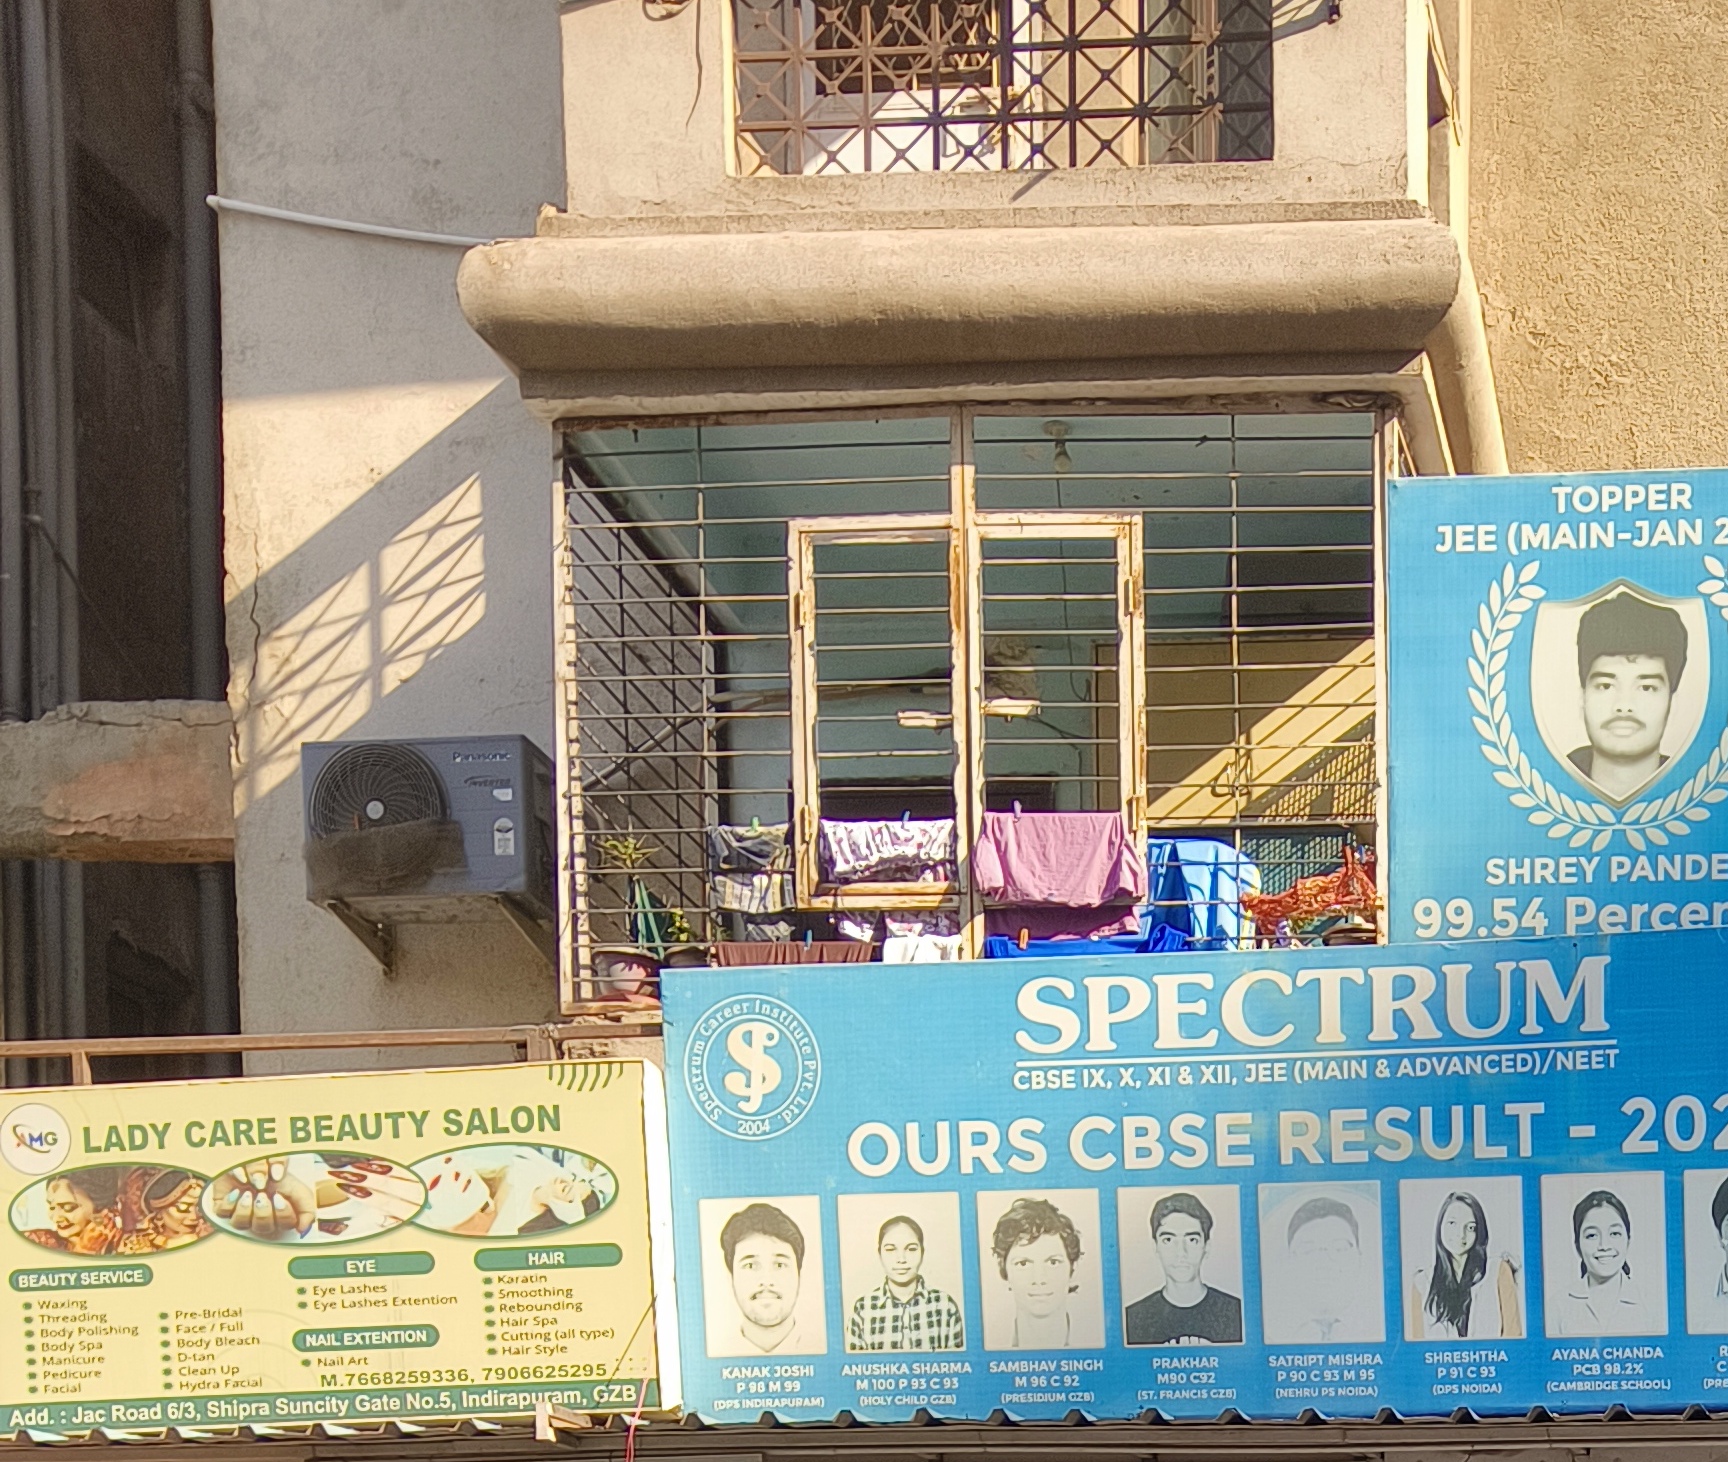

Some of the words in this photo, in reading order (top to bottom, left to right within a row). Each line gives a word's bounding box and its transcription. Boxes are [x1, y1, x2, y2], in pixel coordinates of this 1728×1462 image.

[1552, 482, 1692, 513] TOPPER
[1435, 525, 1498, 553] JEE
[1507, 519, 1702, 554] (MAIN-JAN
[1485, 856, 1601, 885] SHREY
[1413, 896, 1549, 938] 99.54
[1015, 955, 1611, 1054] SPECTRUM
[1013, 1070, 1076, 1091] CBSE
[1082, 1069, 1113, 1091] IX,
[1119, 1069, 1142, 1090] X,
[1148, 1068, 1171, 1086] XI
[1177, 1066, 1194, 1085] &
[1200, 1065, 1236, 1087] XII,
[1245, 1063, 1288, 1083] JEE
[1293, 1059, 1369, 1085] (MAIN
[1375, 1058, 1391, 1078] &
[1396, 1049, 1620, 1079] ADVANCED)/NEET
[83, 1122, 172, 1154] LADY
[184, 1117, 278, 1149] CARE
[289, 1111, 430, 1143] BEAUTY
[443, 1105, 561, 1136] SALON
[847, 1117, 1047, 1177] OURS
[1069, 1112, 1255, 1171] CBSE
[1280, 1102, 1545, 1167] RESULT
[528, 1252, 565, 1265] HAIR
[346, 1260, 376, 1273] EYE
[19, 1273, 78, 1288] BEAUTY
[80, 1270, 144, 1285] SERVICE
[313, 1285, 336, 1296] Eye
[341, 1284, 387, 1294] Lashes
[498, 1286, 573, 1299] Smoothing
[499, 1301, 583, 1313] Rebounding
[306, 1333, 341, 1346] NAIL
[344, 1330, 427, 1346] EXTENTION
[1269, 1354, 1325, 1366] SATRIPT
[1329, 1353, 1383, 1365] MISHRA
[1425, 1350, 1508, 1364] SHRESHTHA
[1552, 1348, 1599, 1361] AYANA
[1603, 1346, 1664, 1359] CHANDA
[842, 1364, 908, 1376] ANUSHKA
[912, 1362, 971, 1375] SHARMA
[989, 1360, 1056, 1373] SAMBHAV
[1060, 1360, 1103, 1372] SINGH
[1153, 1357, 1219, 1369] PRAKHAR
[482, 1364, 607, 1381] 7906625295
[722, 1367, 770, 1380] KANAK
[775, 1365, 814, 1377] JOSHI
[10, 1409, 55, 1427] Add.
[72, 1407, 106, 1424] Jac
[111, 1403, 162, 1420] Road
[167, 1403, 201, 1421] 6/3,
[207, 1399, 270, 1421] Shipra
[276, 1393, 349, 1416] Suncity
[355, 1393, 400, 1412] Gate
[407, 1390, 456, 1411] No.5,
[462, 1389, 587, 1409] Indirapuram,
[594, 1385, 636, 1403] GZB
